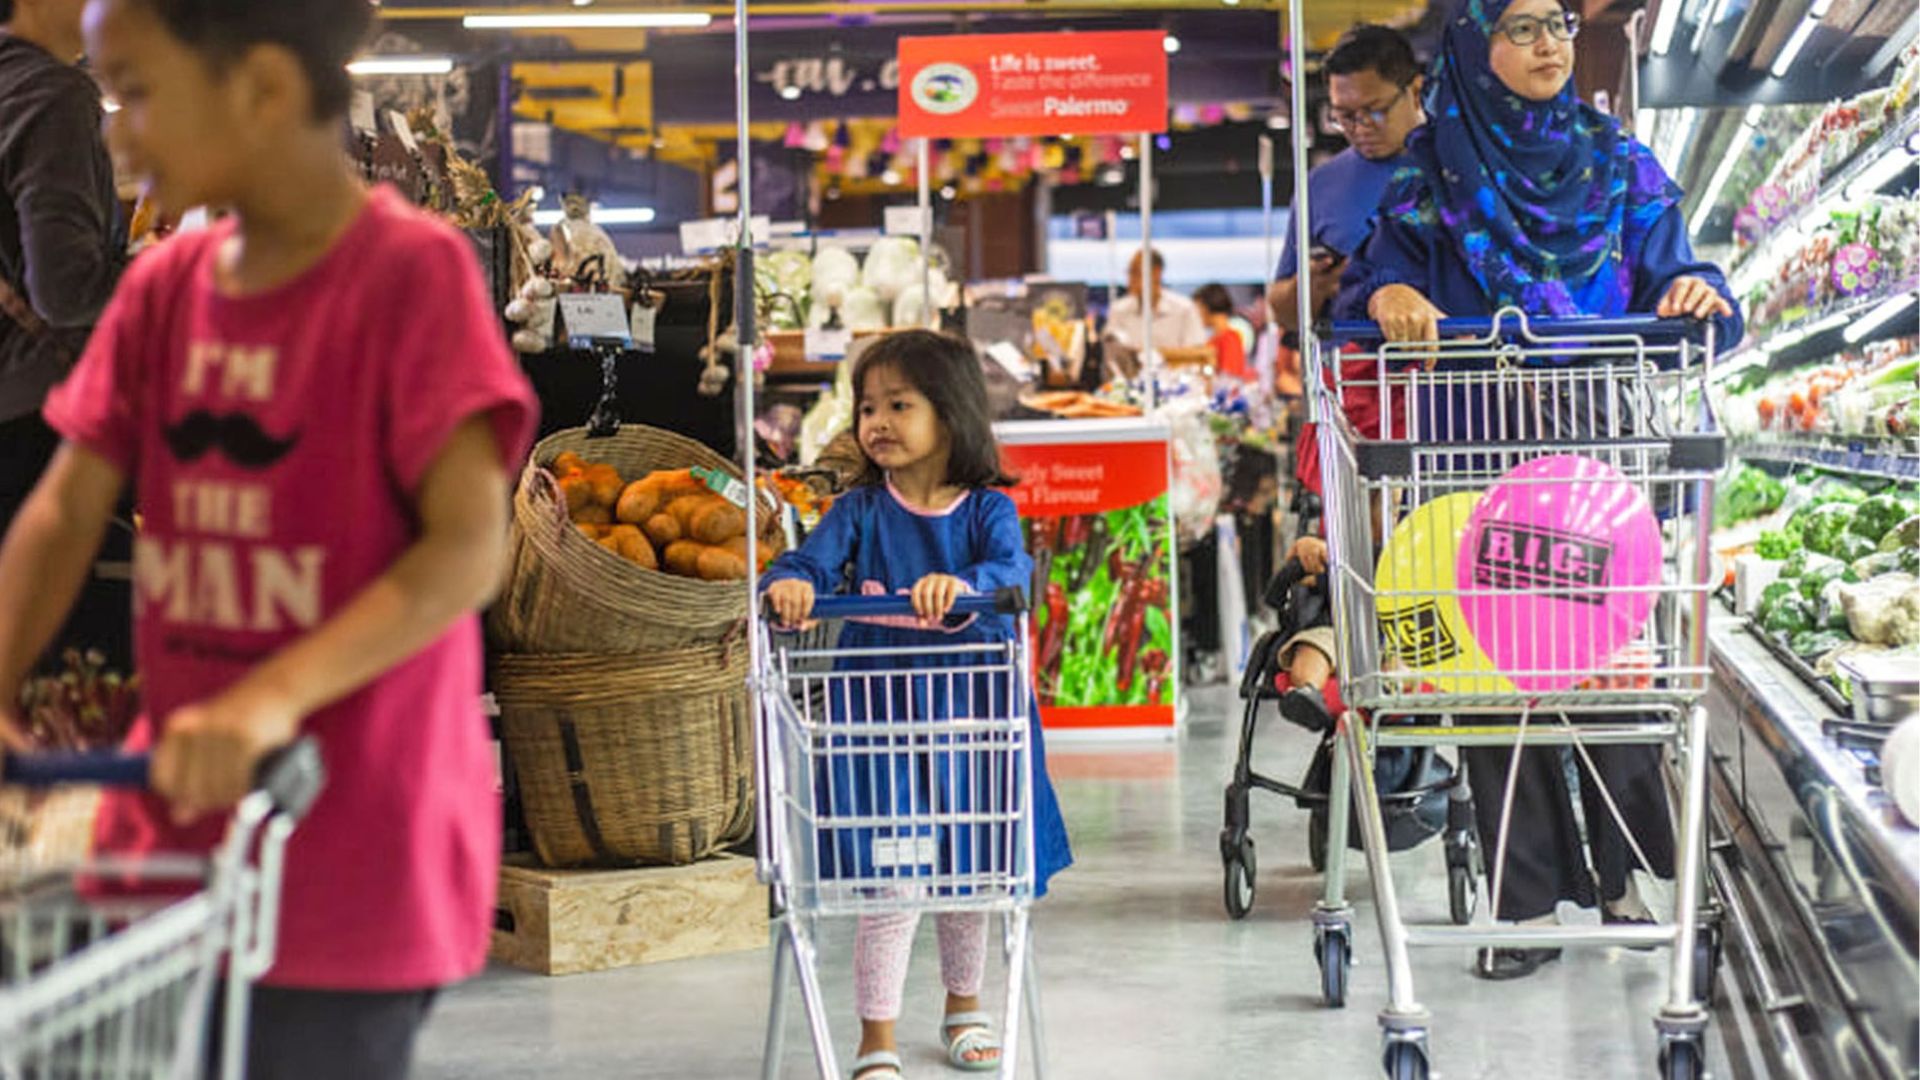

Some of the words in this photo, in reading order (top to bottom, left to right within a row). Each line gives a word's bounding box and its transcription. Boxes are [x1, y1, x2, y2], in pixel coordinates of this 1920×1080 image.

[990, 54, 1022, 73] Life
[1026, 54, 1041, 71] is
[1044, 55, 1101, 71] sweet.
[990, 74, 1036, 90] Taste
[1039, 73, 1066, 88] the
[1069, 73, 1152, 88] difference
[182, 342, 275, 399] I'M
[1052, 464, 1104, 482] Sweet
[173, 480, 271, 537] THE
[1032, 486, 1101, 504] Flavour
[1482, 530, 1601, 577] B.I.G.
[135, 538, 325, 631] MAN
